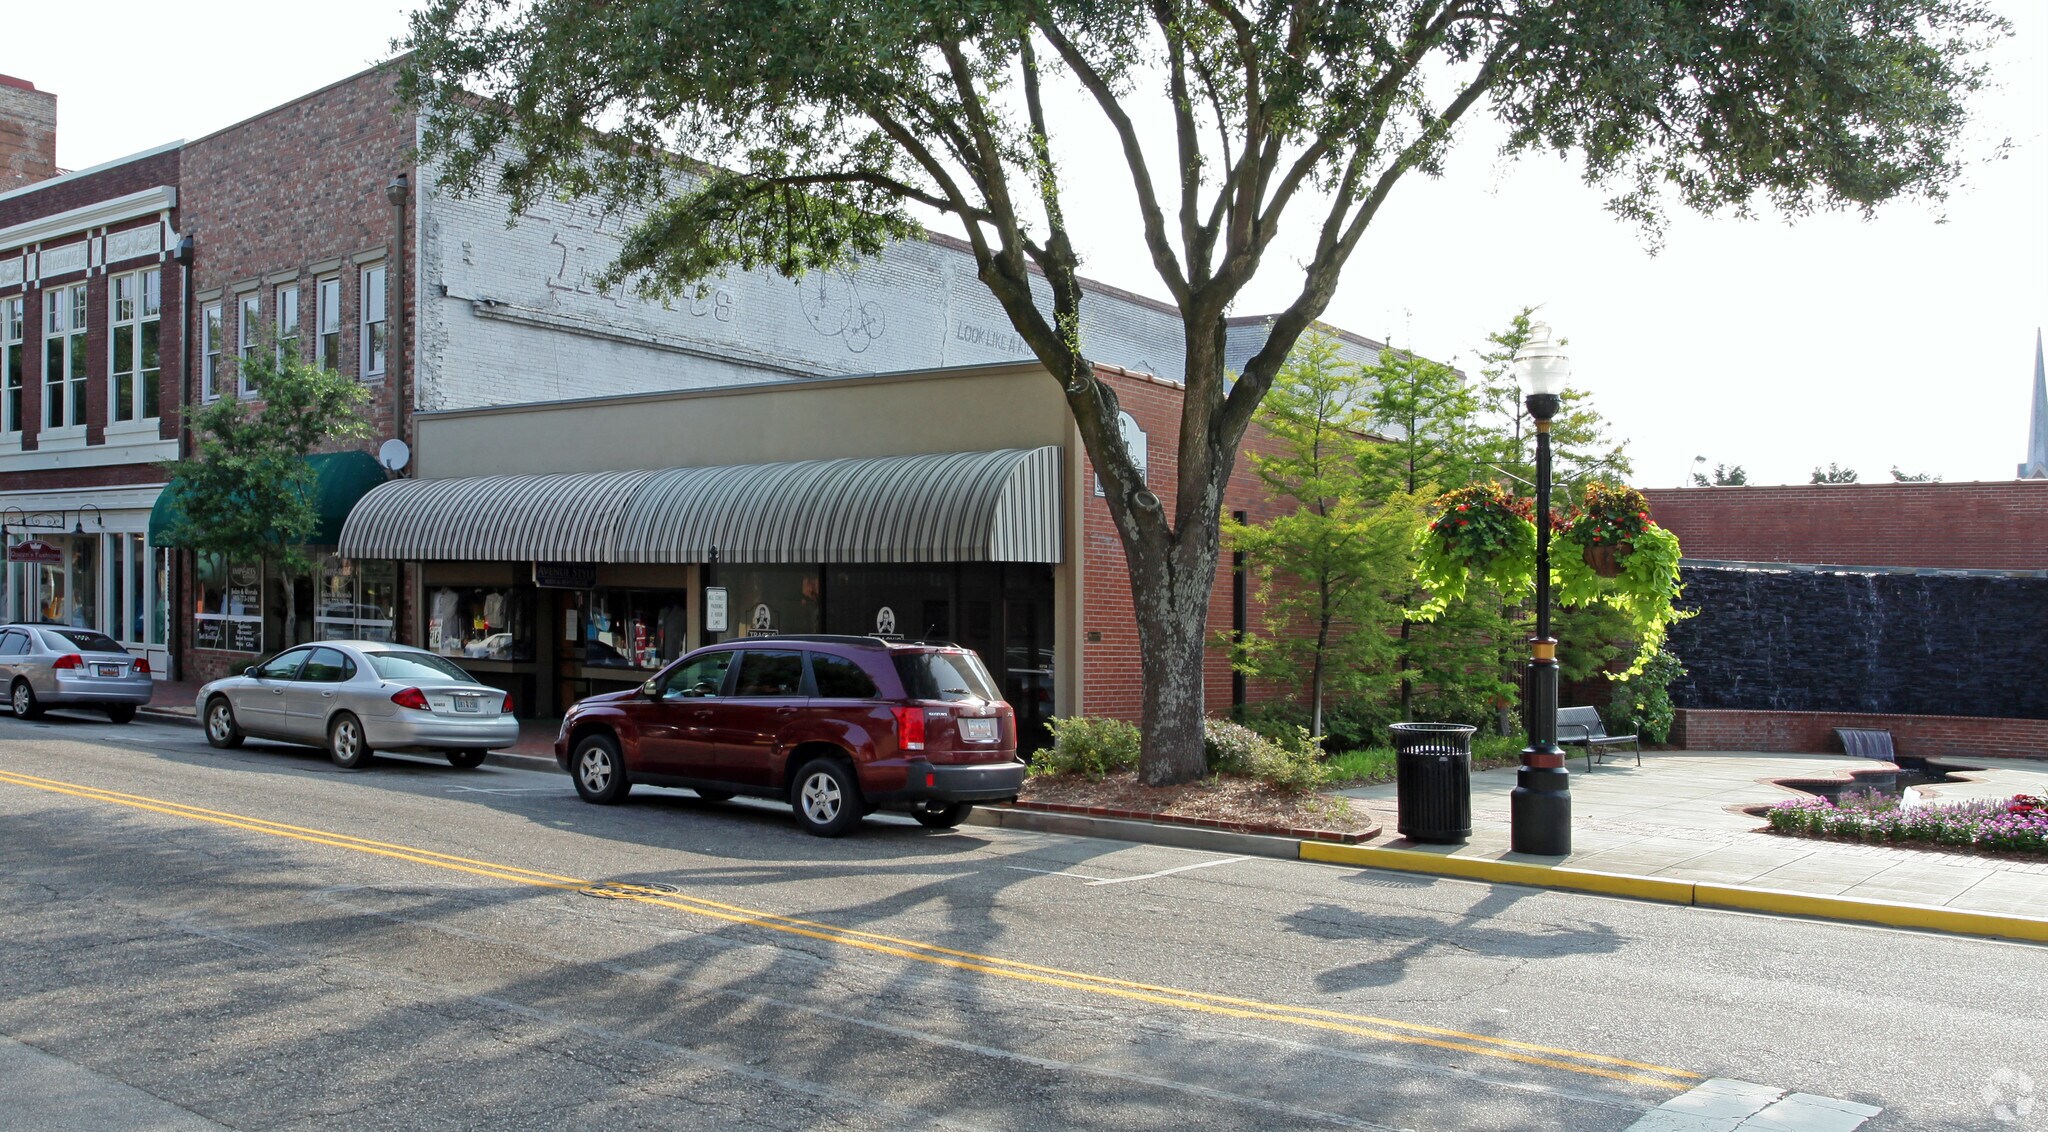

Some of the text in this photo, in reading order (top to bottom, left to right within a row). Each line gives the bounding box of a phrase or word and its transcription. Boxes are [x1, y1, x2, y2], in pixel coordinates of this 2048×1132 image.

[957, 321, 984, 345] LOOK
[986, 328, 1006, 350] LIKE
[1009, 332, 1015, 353] A
